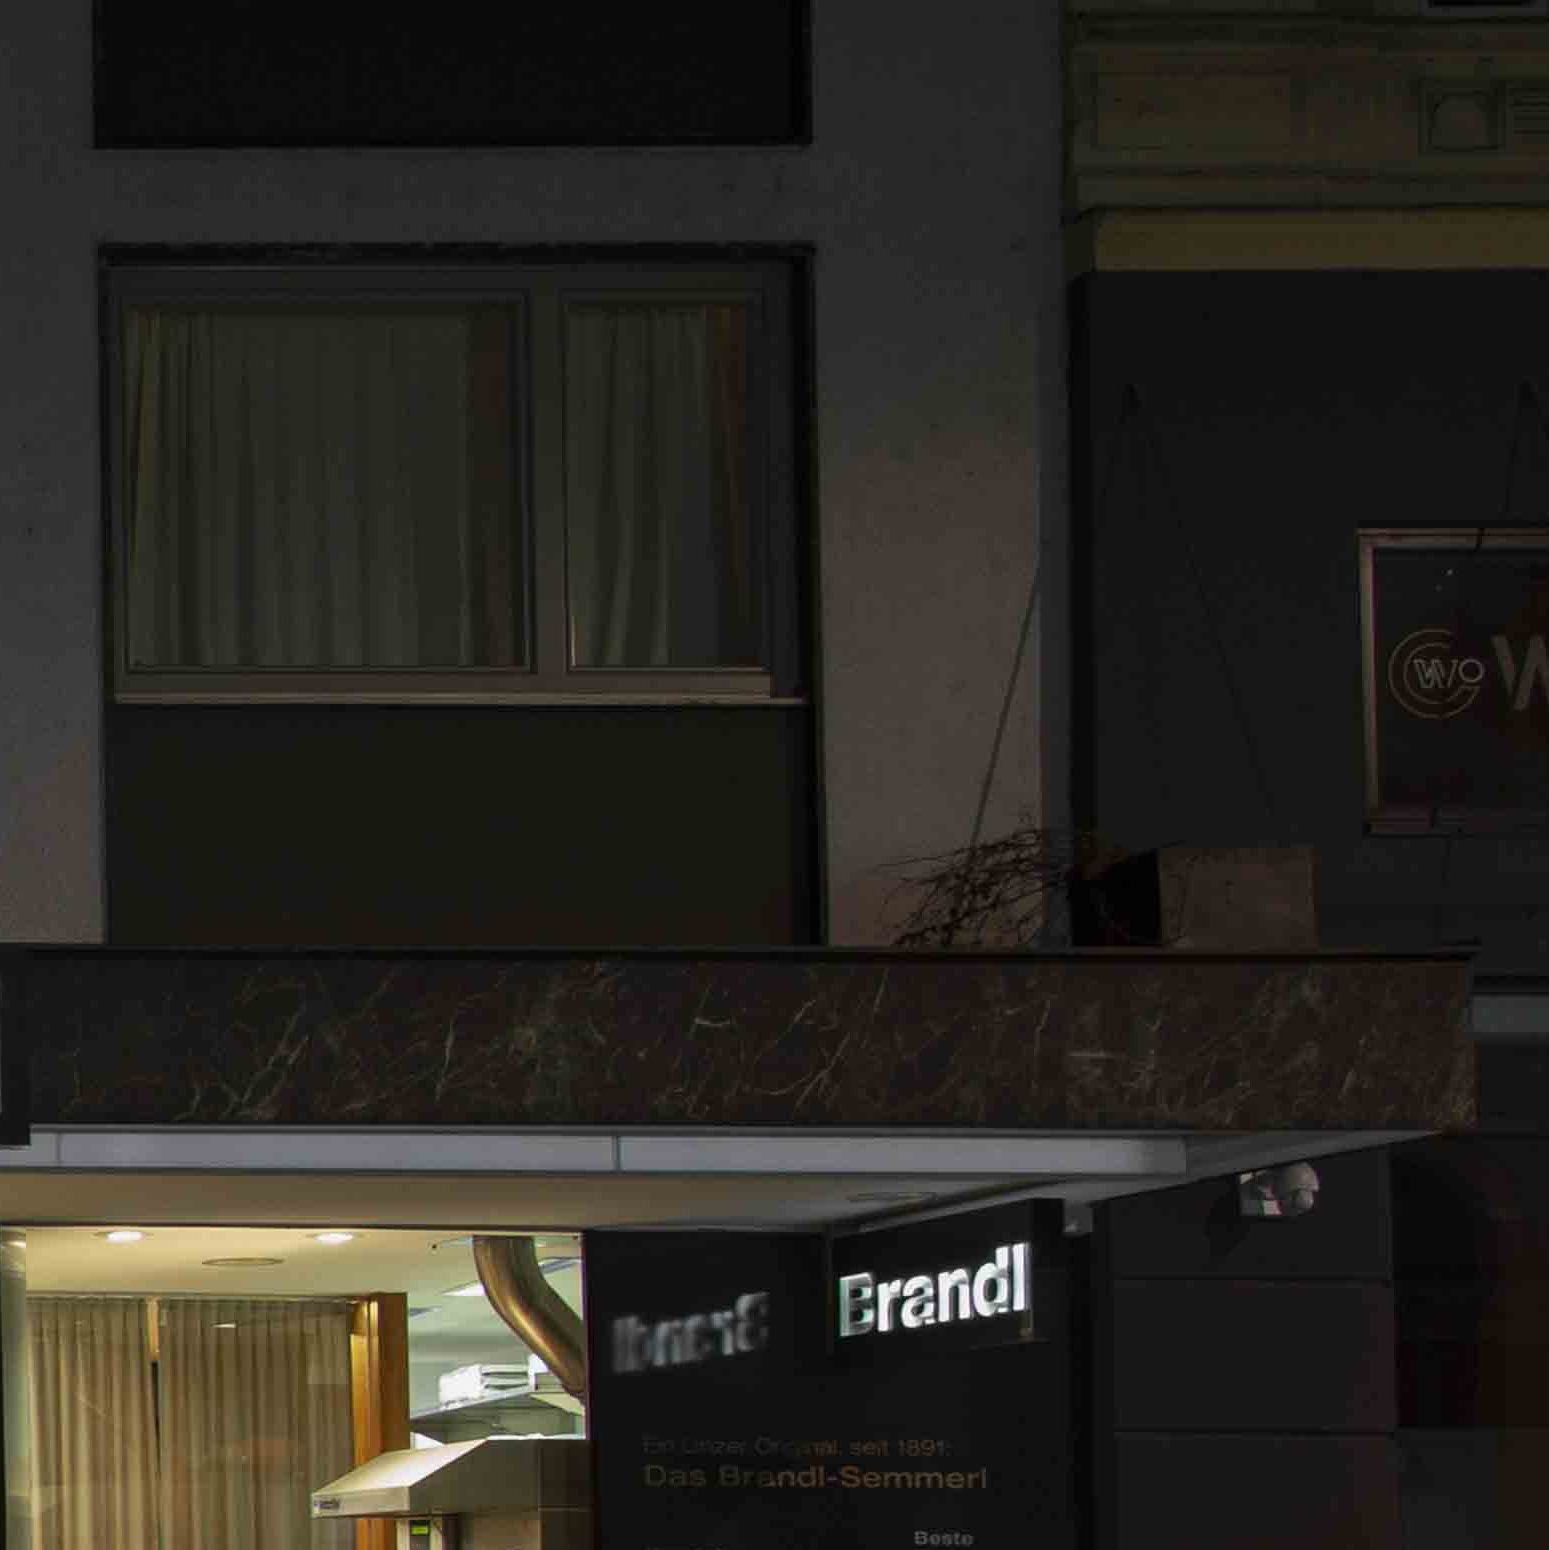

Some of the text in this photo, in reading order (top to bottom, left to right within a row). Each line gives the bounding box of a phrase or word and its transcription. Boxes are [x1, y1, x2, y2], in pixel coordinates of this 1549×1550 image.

[837, 1242, 1032, 1339] Brandl
[849, 1436, 889, 1456] seit
[644, 1465, 987, 1489] Das Brandl-Semmerl
[913, 1530, 974, 1547] Beste
